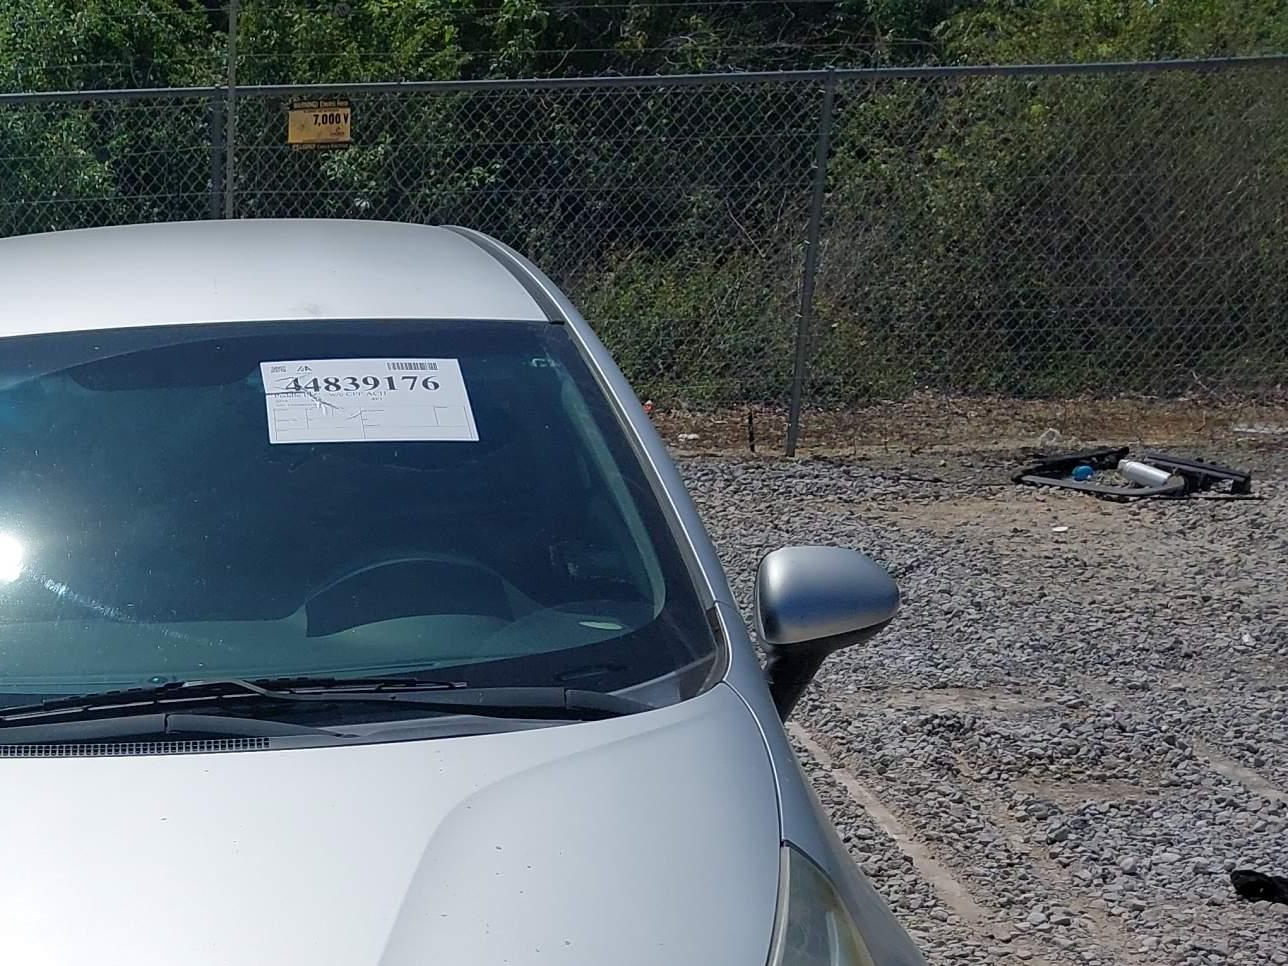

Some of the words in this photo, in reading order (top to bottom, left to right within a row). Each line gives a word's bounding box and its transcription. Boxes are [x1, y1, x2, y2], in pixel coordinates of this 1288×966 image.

[313, 114, 341, 126] 7,000
[343, 113, 349, 124] V
[285, 375, 440, 392] 44839176
